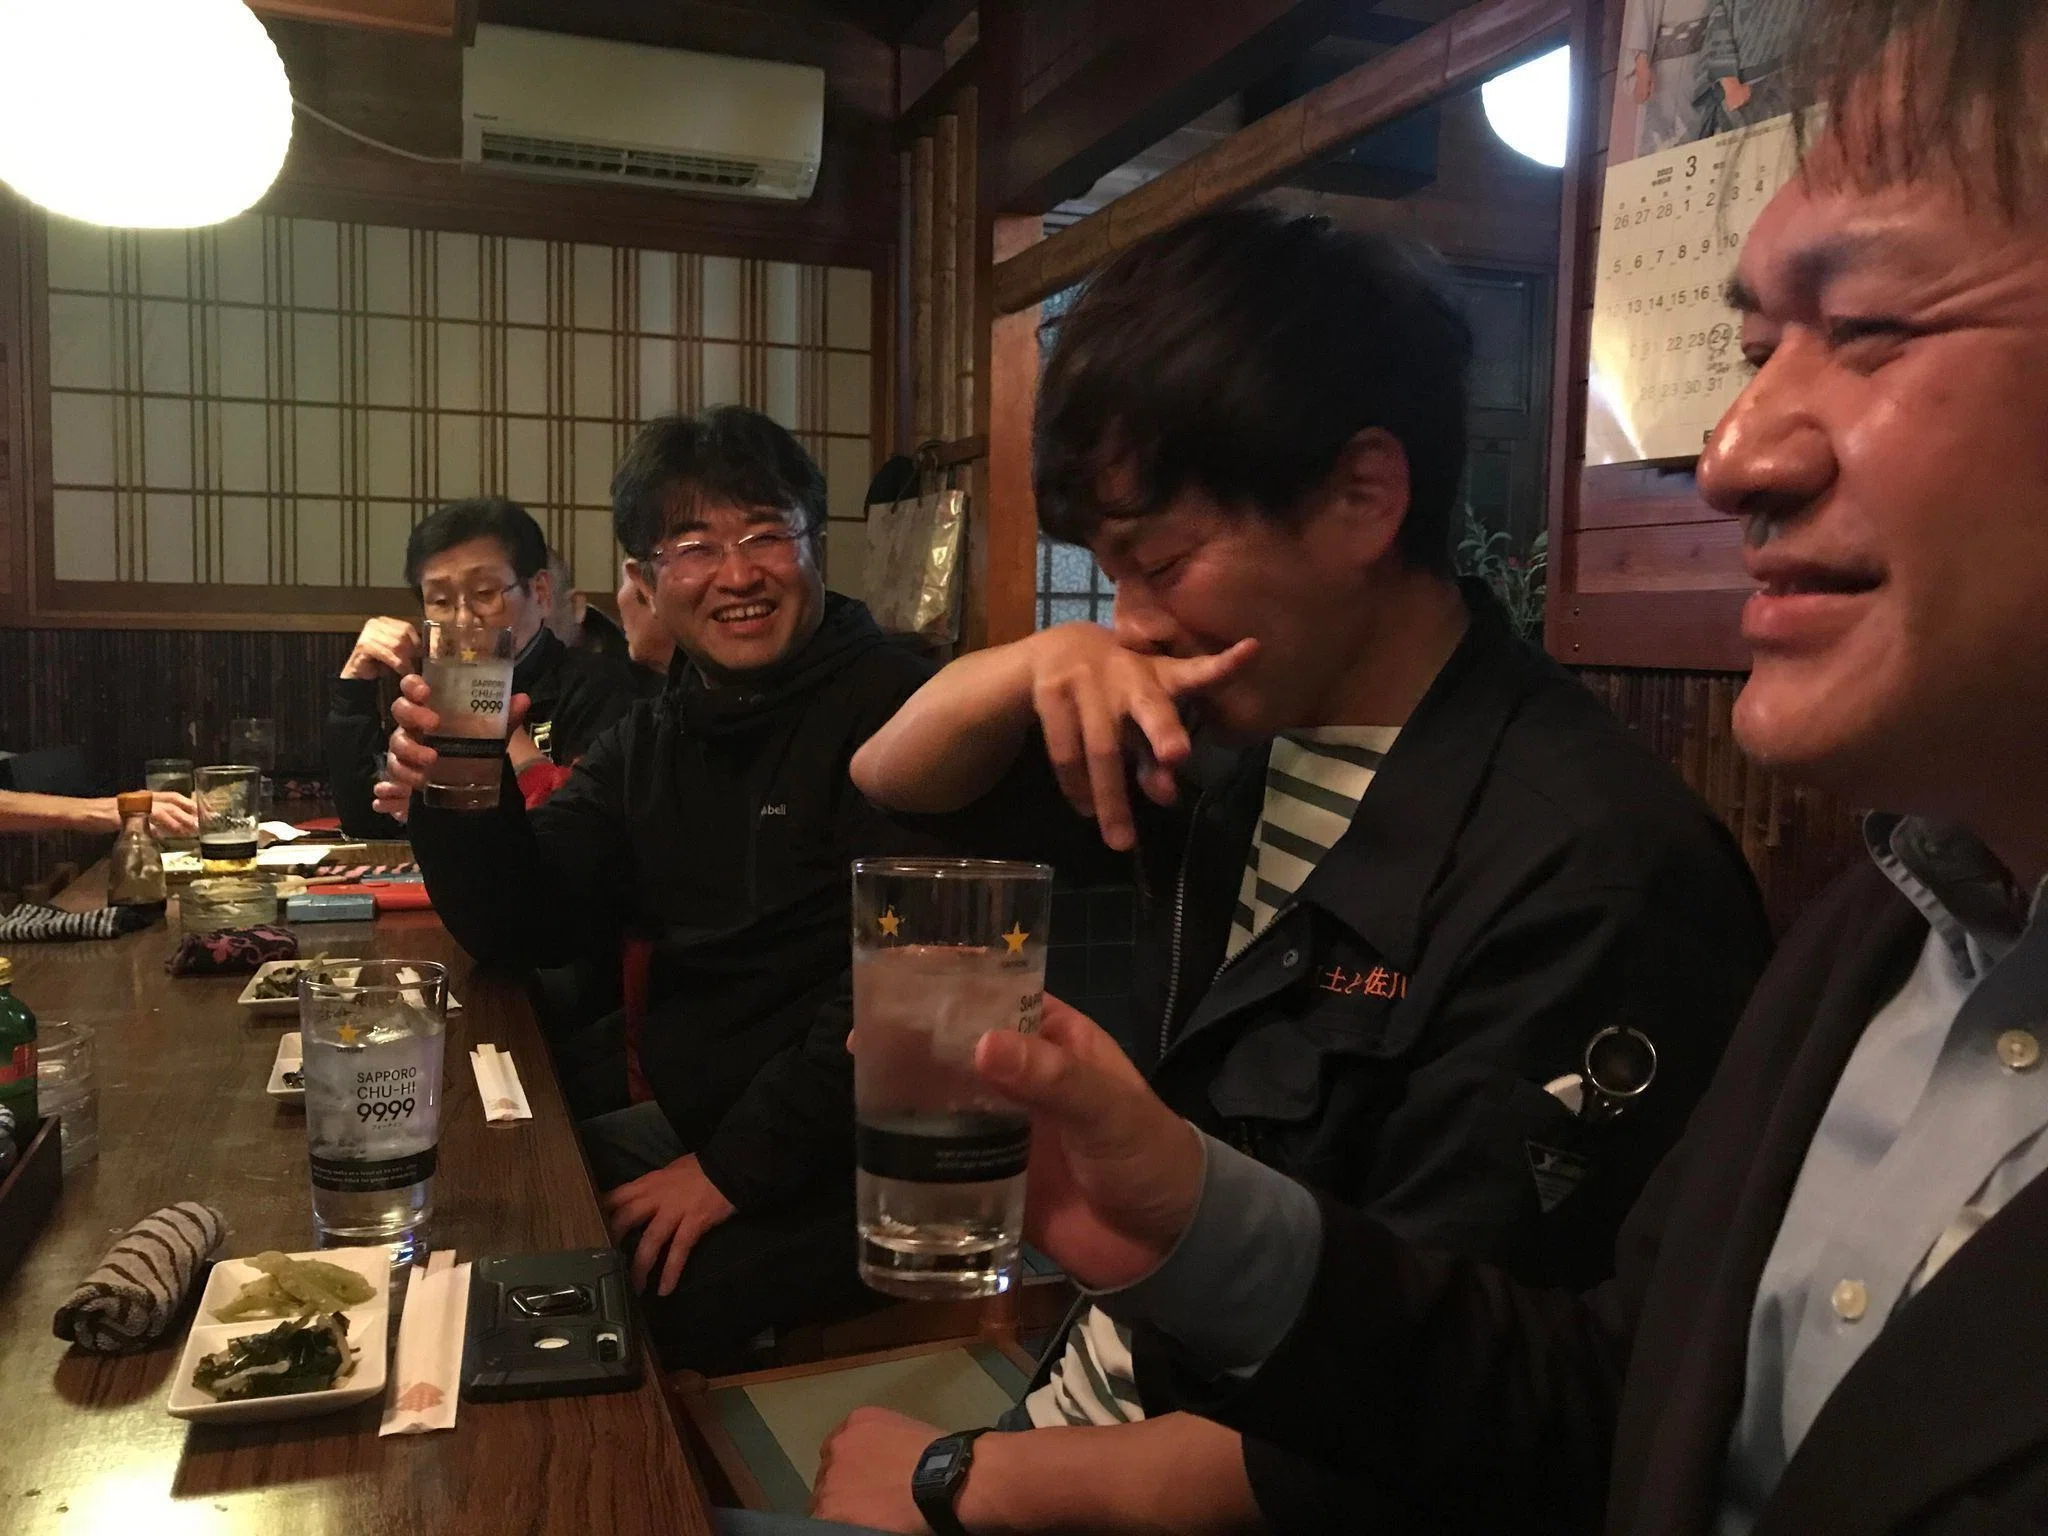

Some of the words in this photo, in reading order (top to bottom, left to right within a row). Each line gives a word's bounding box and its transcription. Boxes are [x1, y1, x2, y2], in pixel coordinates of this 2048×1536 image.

[1685, 155, 1697, 178] 3
[1612, 213, 1630, 231] 26
[1634, 208, 1652, 225] 27
[1656, 202, 1673, 220] 28
[1684, 198, 1691, 213] 1
[1704, 192, 1716, 208] 2
[1731, 185, 1740, 201] 3
[1754, 179, 1764, 193] 4
[1613, 258, 1622, 274] 5
[1634, 253, 1643, 269] 6
[1655, 249, 1664, 263] 7
[1678, 244, 1688, 259] 8
[1700, 239, 1711, 254] 9
[1722, 232, 1739, 249] 10
[1627, 299, 1642, 314] 13
[1648, 294, 1664, 310] 14
[1670, 288, 1687, 305] 15
[1693, 285, 1710, 301] 16
[1665, 335, 1683, 352] 22
[1687, 331, 1706, 348] 23
[356, 1066, 417, 1084] SAPPORO
[356, 1080, 416, 1100] CHU-HI
[356, 1097, 416, 1124] 99.99
